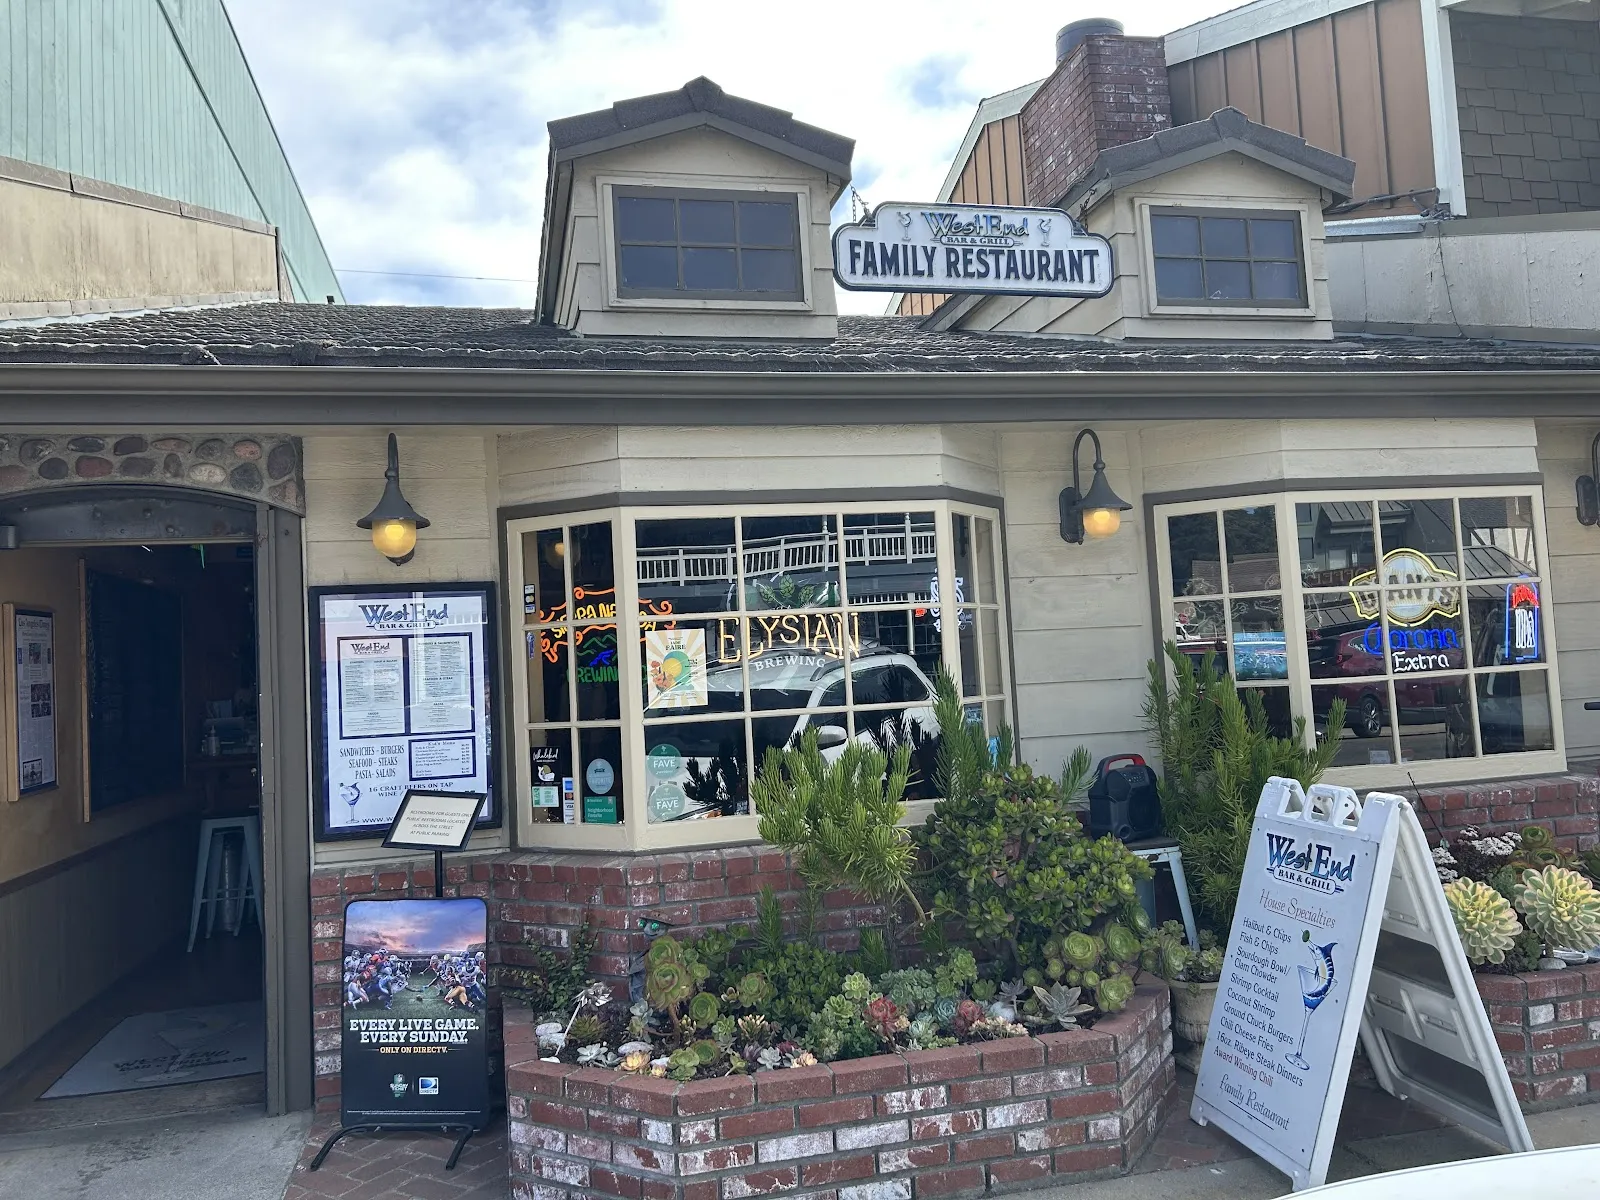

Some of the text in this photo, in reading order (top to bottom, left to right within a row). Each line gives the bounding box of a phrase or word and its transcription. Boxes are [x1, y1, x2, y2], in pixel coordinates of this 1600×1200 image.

[921, 212, 1029, 237] West End
[982, 237, 1010, 245] GRILL
[849, 239, 1100, 284] FAMILY RESTAURANT
[358, 603, 449, 625] West End
[373, 642, 390, 651] End
[718, 613, 860, 663] ELYSIAN
[1363, 622, 1459, 655] Corona
[754, 655, 827, 672] BREWING
[1392, 651, 1450, 672] Extra
[340, 746, 375, 757] SANDWICHES
[381, 745, 404, 755] BURGERS
[348, 758, 373, 768] SEAFOOD
[378, 756, 398, 766] STEAKS
[653, 759, 676, 768] FAVE
[375, 768, 396, 778] SALADS
[656, 800, 679, 810] FAVE
[1266, 832, 1356, 882] West End
[1278, 869, 1331, 891] BAR & GRILL
[1260, 888, 1336, 929] House Specialties
[1242, 916, 1292, 943] Halibut & Chips
[1239, 931, 1279, 956] Fish & Chips
[1236, 945, 1270, 969] Sourdough
[1234, 957, 1278, 984] Clam Chowder
[1230, 972, 1280, 1003] Shrimp Cocktail
[1227, 987, 1276, 1020] Coconut Shrimp
[349, 1018, 480, 1031] EVERY LIVE GAME.
[1220, 1016, 1274, 1052] Chili Cheese Fries
[1223, 1001, 1294, 1045] Ground Chuck Burgers
[360, 1031, 469, 1043] EVERY SUNDAY.
[380, 1046, 448, 1054] ONLY ON DIRECTV.
[1213, 1045, 1274, 1088] Award Winning Chili
[1233, 1039, 1255, 1060] Ribeye
[1256, 1052, 1276, 1072] Steak
[1276, 1063, 1304, 1087] Dinners
[1245, 1088, 1290, 1131] Restaurant
